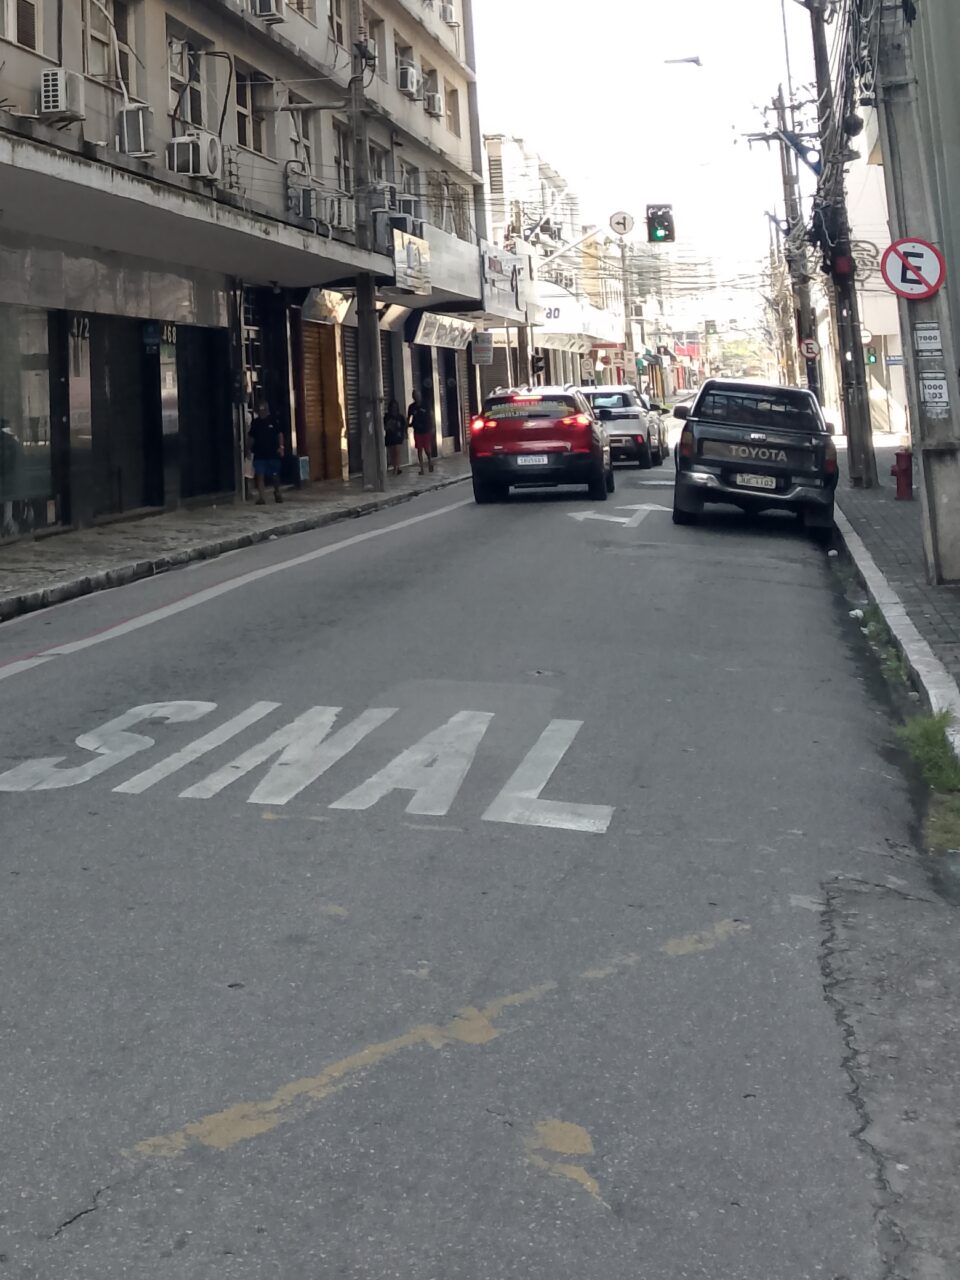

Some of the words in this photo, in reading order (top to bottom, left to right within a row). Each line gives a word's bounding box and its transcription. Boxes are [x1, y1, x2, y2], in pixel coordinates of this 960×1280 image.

[901, 251, 924, 285] E
[806, 342, 814, 354] E
[729, 445, 788, 462] TOYOTA
